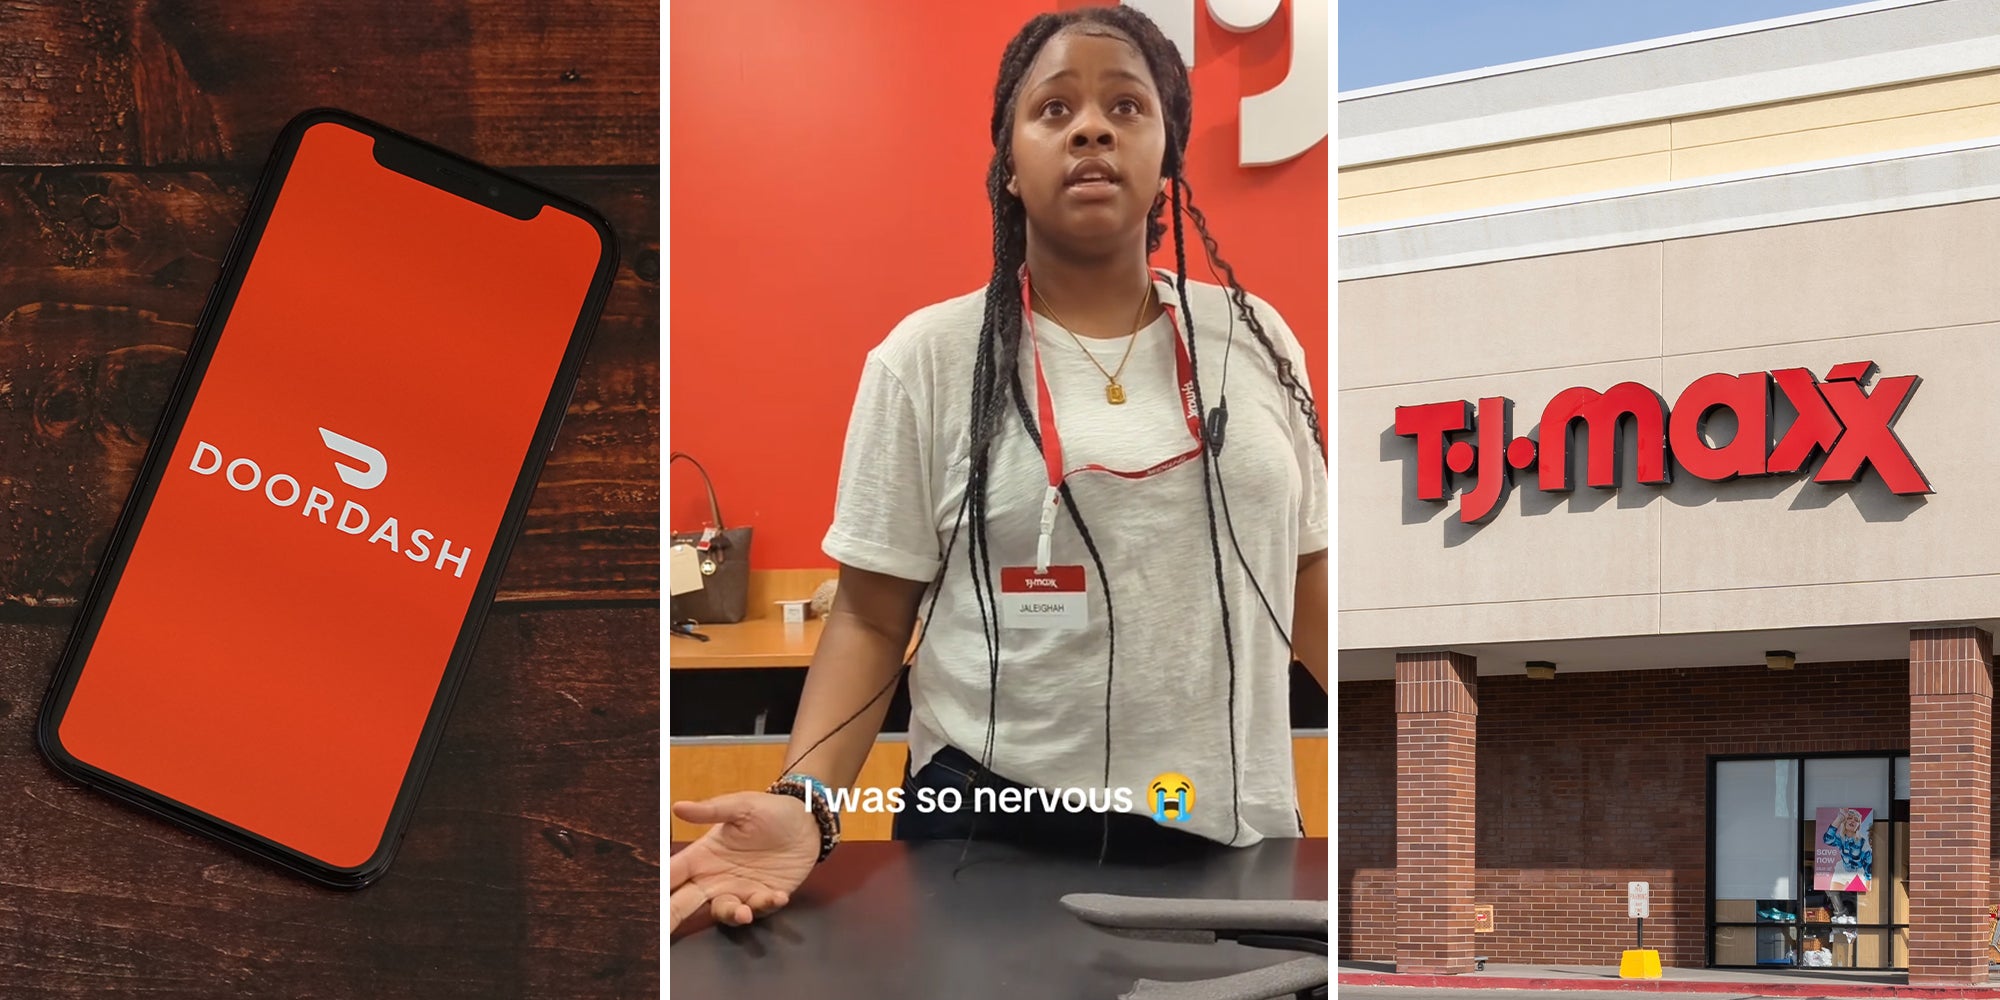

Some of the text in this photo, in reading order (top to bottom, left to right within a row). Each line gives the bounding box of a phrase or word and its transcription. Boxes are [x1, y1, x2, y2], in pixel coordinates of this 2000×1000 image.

[189, 440, 471, 578] DOORDASH
[1019, 604, 1065, 613] JALEIGHAH
[1816, 848, 1837, 856] save
[1816, 856, 1835, 864] now
